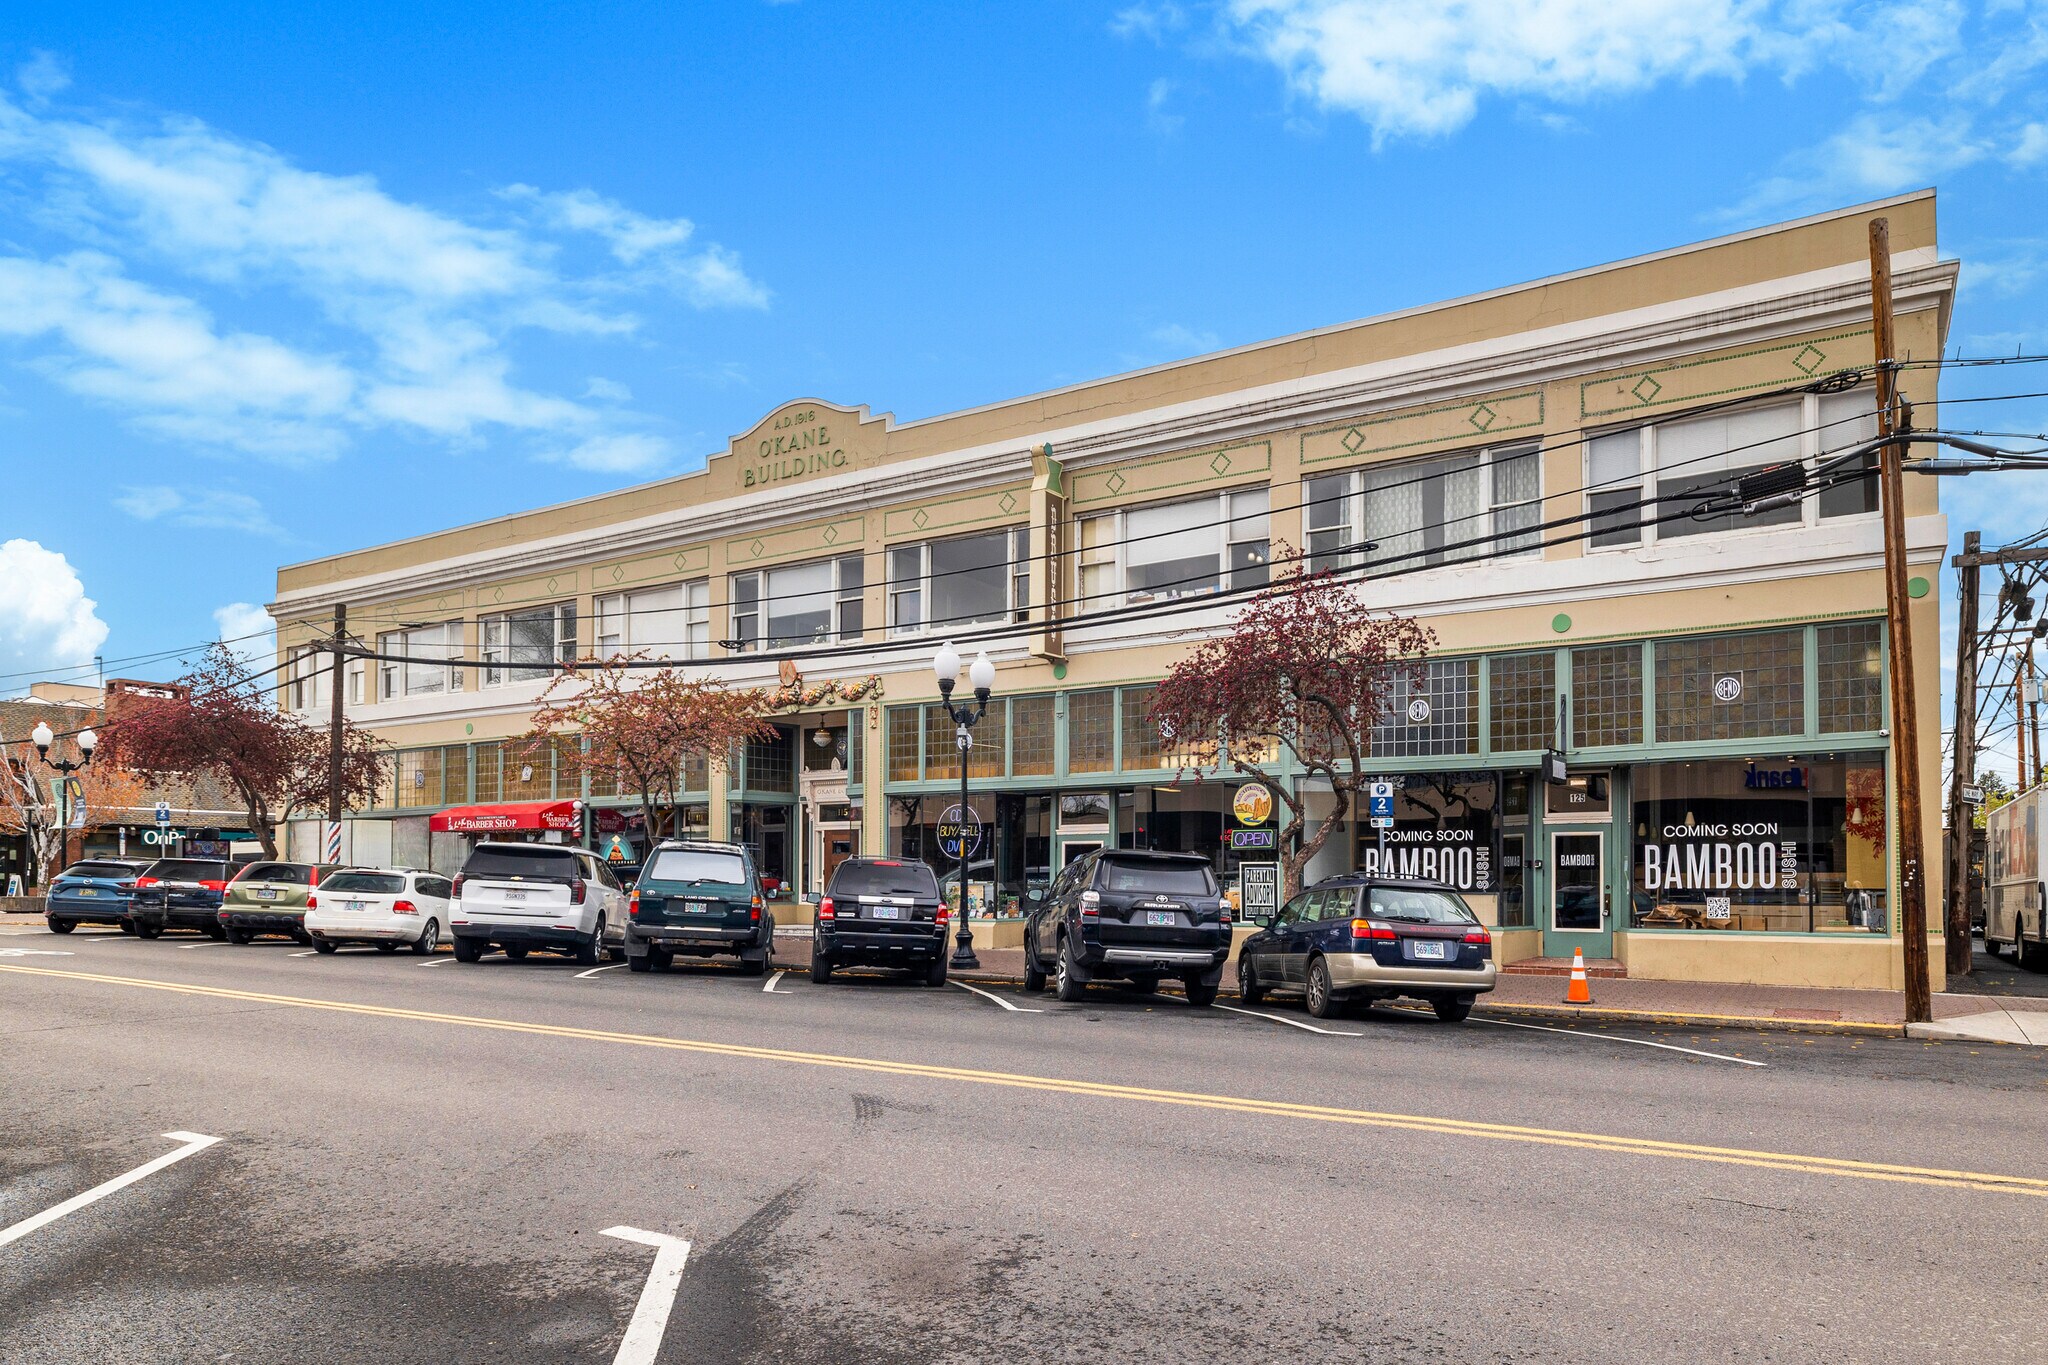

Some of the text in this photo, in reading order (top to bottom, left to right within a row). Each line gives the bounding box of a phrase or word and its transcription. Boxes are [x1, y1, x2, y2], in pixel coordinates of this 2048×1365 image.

[1717, 680, 1738, 698] BEND
[1410, 701, 1428, 719] BEND
[1377, 797, 1386, 809] 2
[1570, 793, 1585, 803] 125
[466, 819, 494, 829] BARBER
[494, 818, 517, 828] SHOP
[1663, 822, 1778, 838] COMING SOON
[1234, 831, 1272, 846] OPEN
[1383, 829, 1474, 843] COMING SOON
[1560, 854, 1591, 866] BAMBOO
[1644, 841, 1777, 890] BAMBOO
[1781, 841, 1798, 889] SUSHI
[1365, 846, 1473, 890] BAMBOO
[1475, 846, 1490, 890] SUSHI
[1246, 869, 1273, 883] PARENTAL
[1246, 884, 1273, 905] ADVISORY
[1415, 944, 1427, 954] 569
